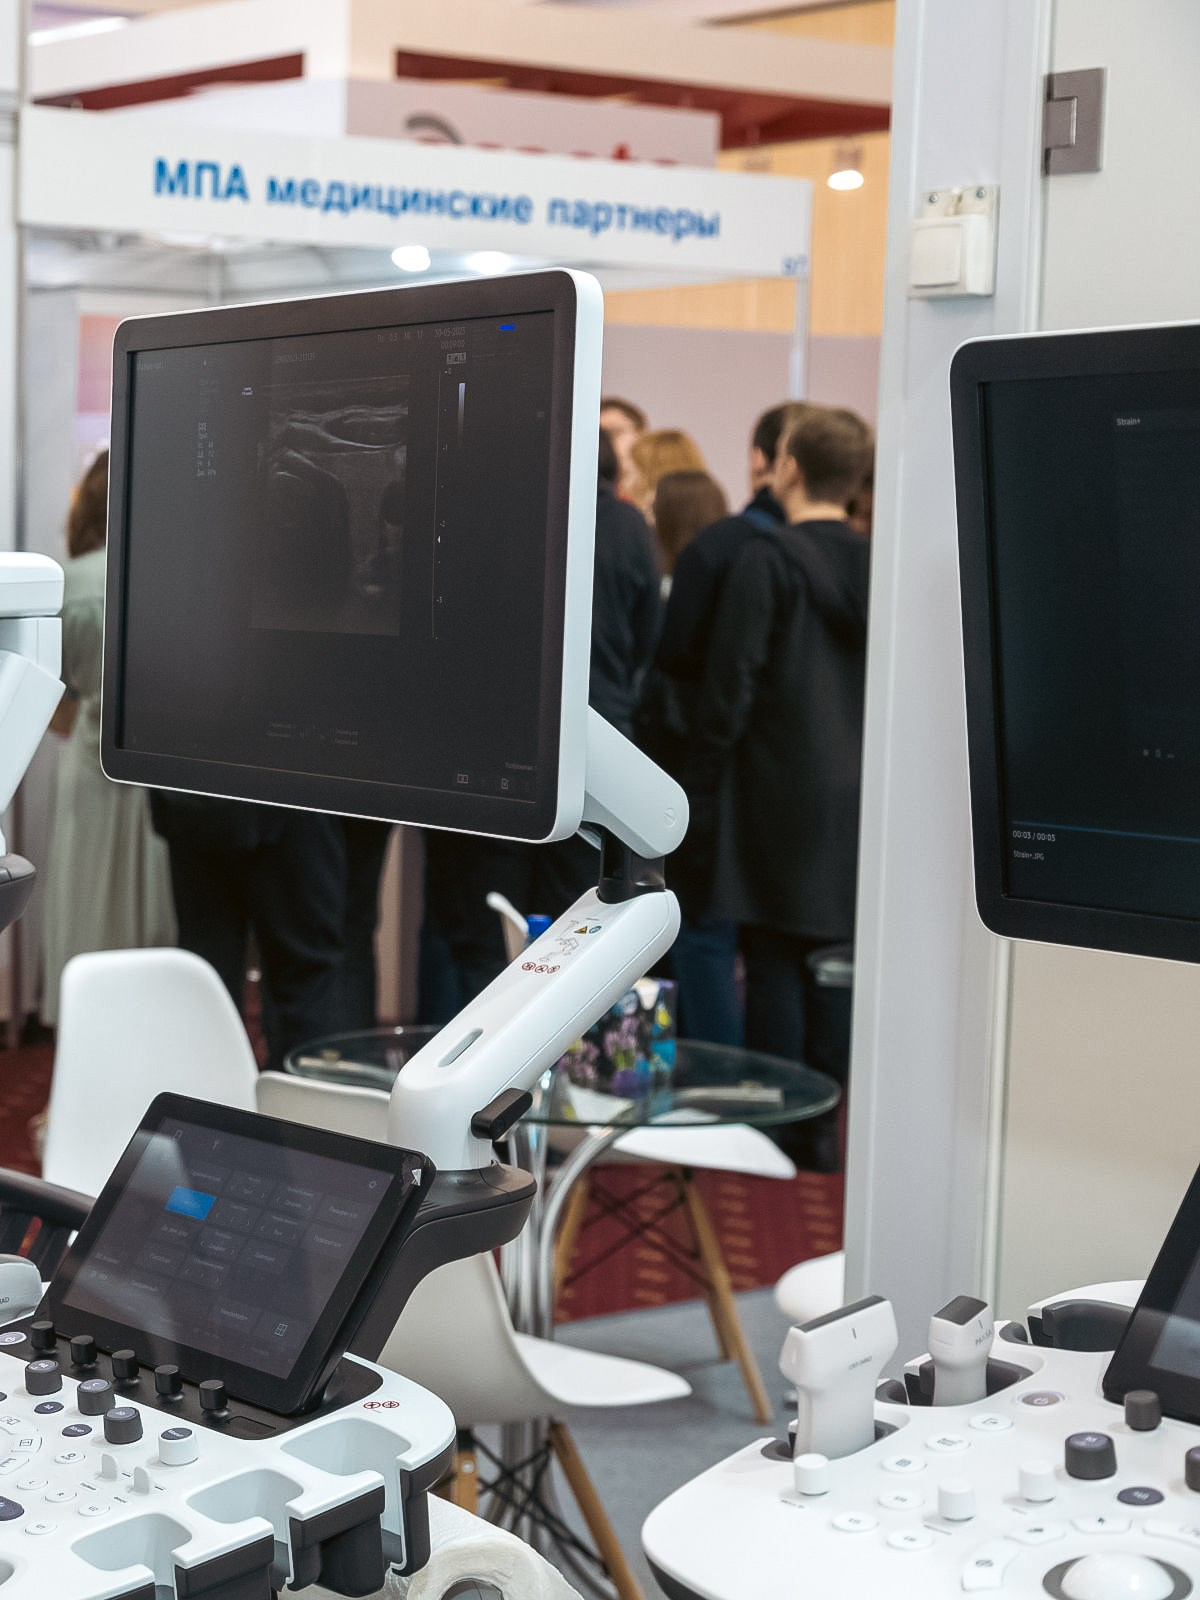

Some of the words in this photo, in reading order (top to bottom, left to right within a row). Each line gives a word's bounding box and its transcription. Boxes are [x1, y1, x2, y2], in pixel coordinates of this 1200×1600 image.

[154, 158, 248, 202] МПА
[266, 176, 534, 224] медицинские
[546, 196, 721, 243] партнеры
[1012, 830, 1031, 840] 00:03
[1036, 832, 1056, 842] 00:05
